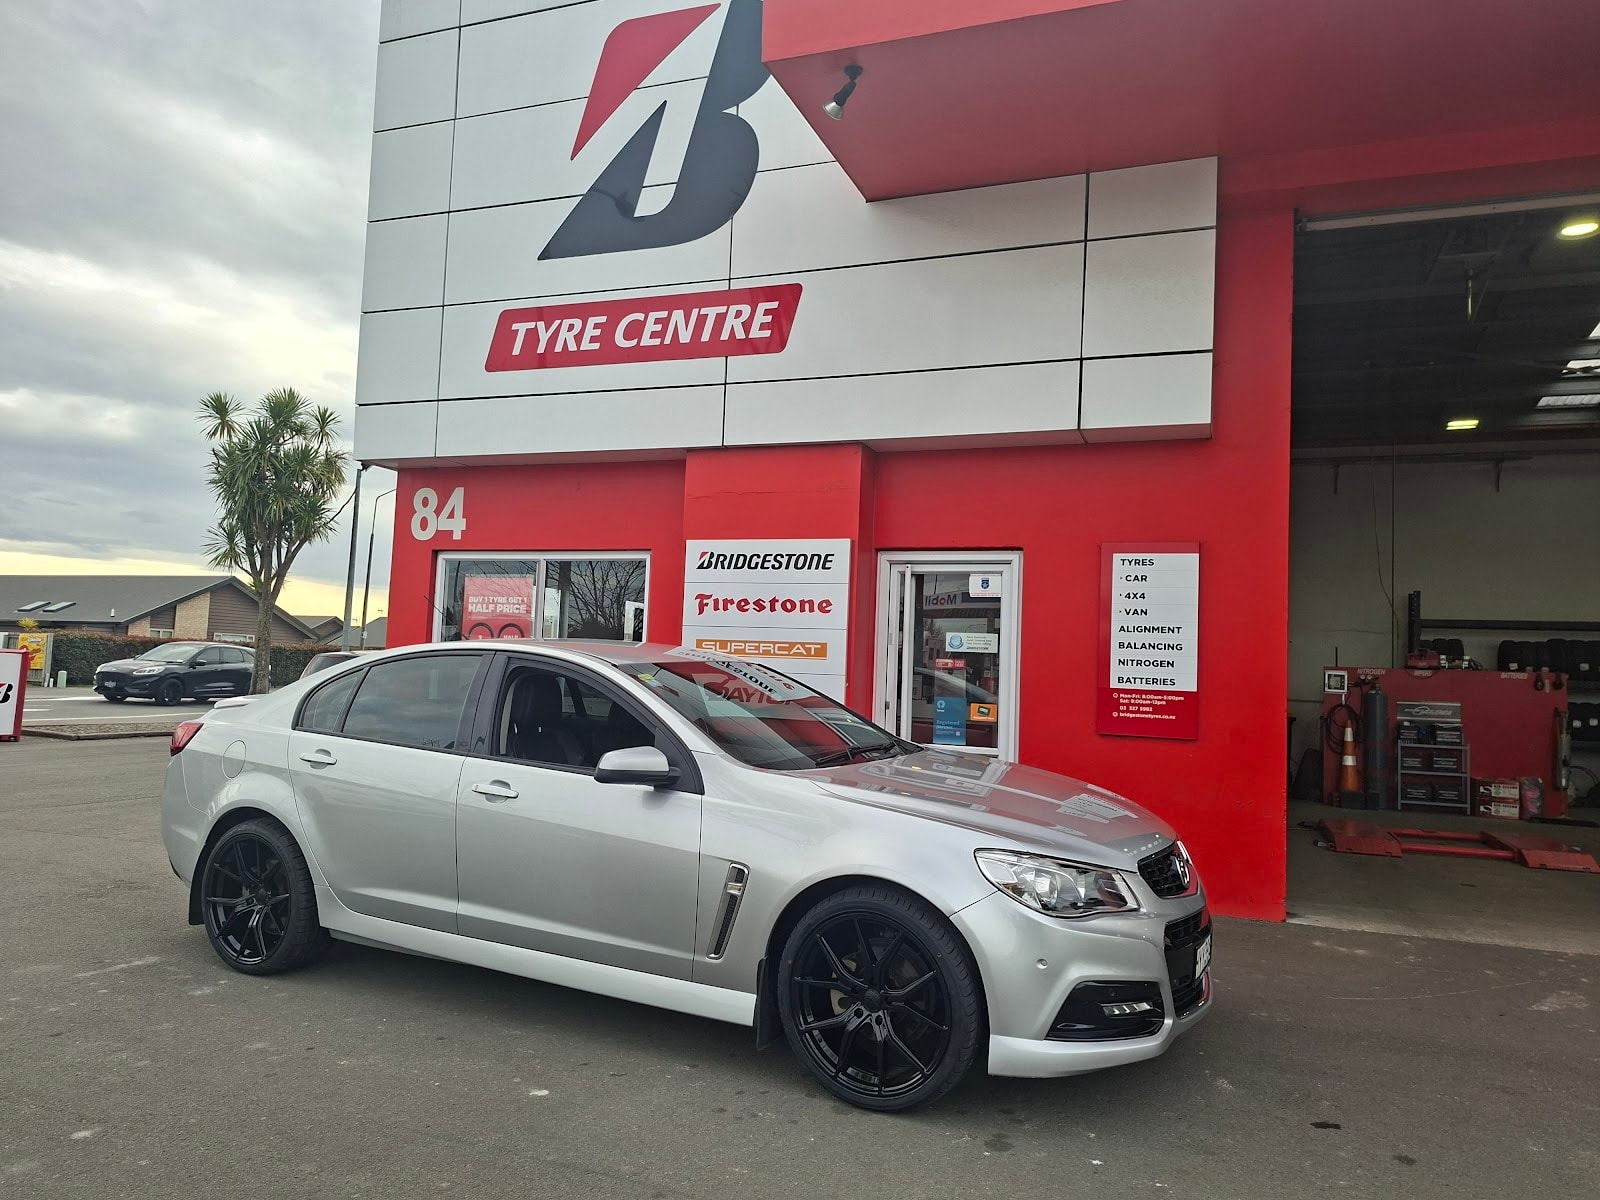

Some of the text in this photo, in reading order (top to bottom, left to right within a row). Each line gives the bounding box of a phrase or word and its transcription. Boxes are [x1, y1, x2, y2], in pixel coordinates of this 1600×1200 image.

[511, 301, 780, 356] TYRE CENTRE
[410, 486, 467, 541] 84
[696, 550, 835, 571] BRIDGESTONE
[1120, 558, 1154, 566] TYRES
[1125, 574, 1148, 583] CAR
[1124, 592, 1146, 600] 4X4
[468, 603, 527, 613] HALF PRICE
[694, 593, 833, 616] Firestone
[1124, 607, 1148, 616] VAN
[1118, 625, 1183, 635] ALIGNMENT
[701, 641, 822, 656] SUPERCAT
[1118, 641, 1184, 651] BALANCING
[1117, 658, 1175, 668] NITROGEN
[1117, 676, 1175, 686] BATTERIES
